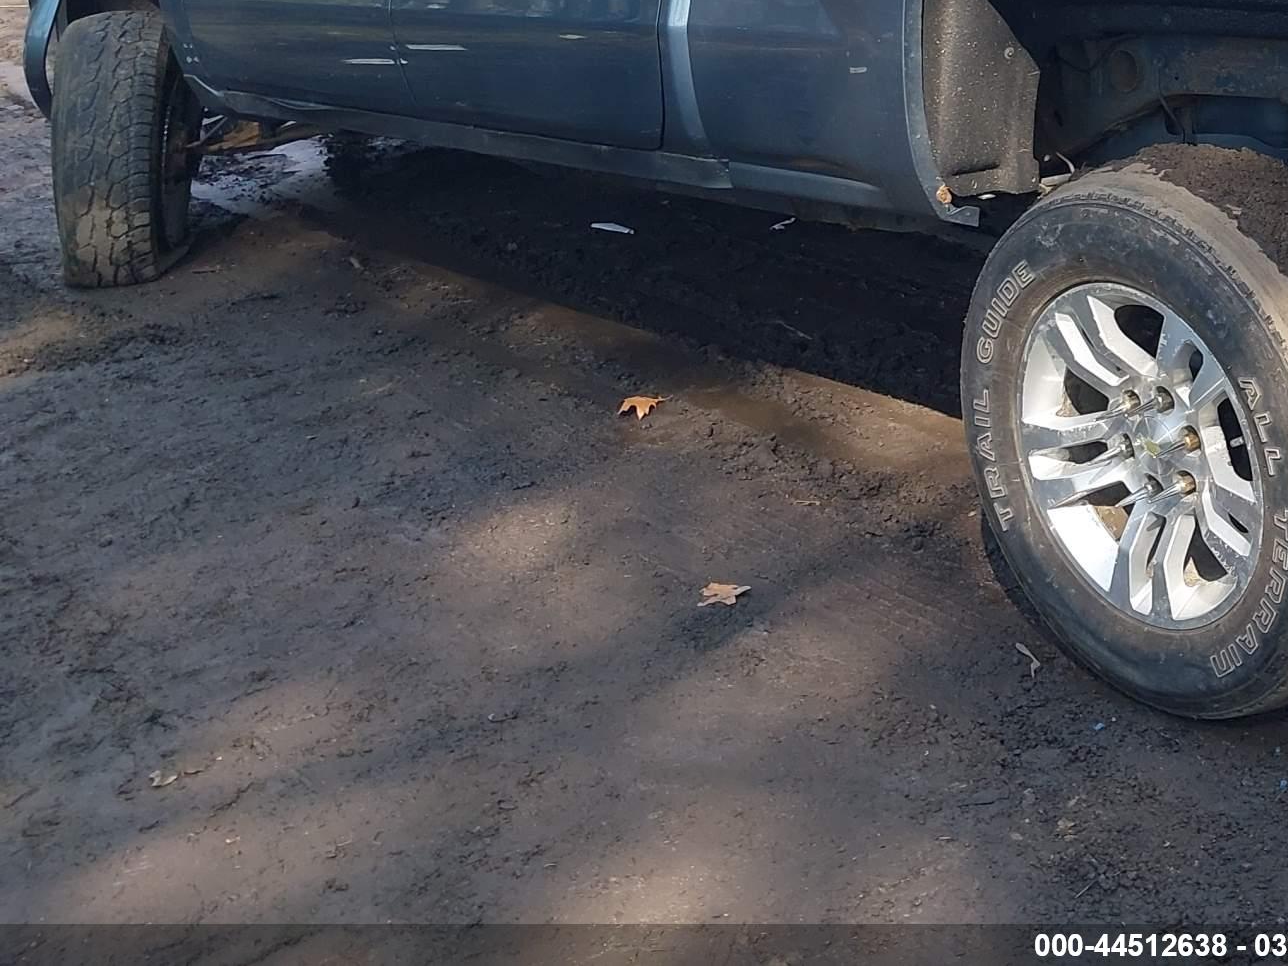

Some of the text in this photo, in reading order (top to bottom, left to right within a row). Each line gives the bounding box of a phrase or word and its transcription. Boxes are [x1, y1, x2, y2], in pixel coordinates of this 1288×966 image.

[973, 259, 1037, 532] TRAIL GUIDE
[1238, 376, 1282, 477] ALL
